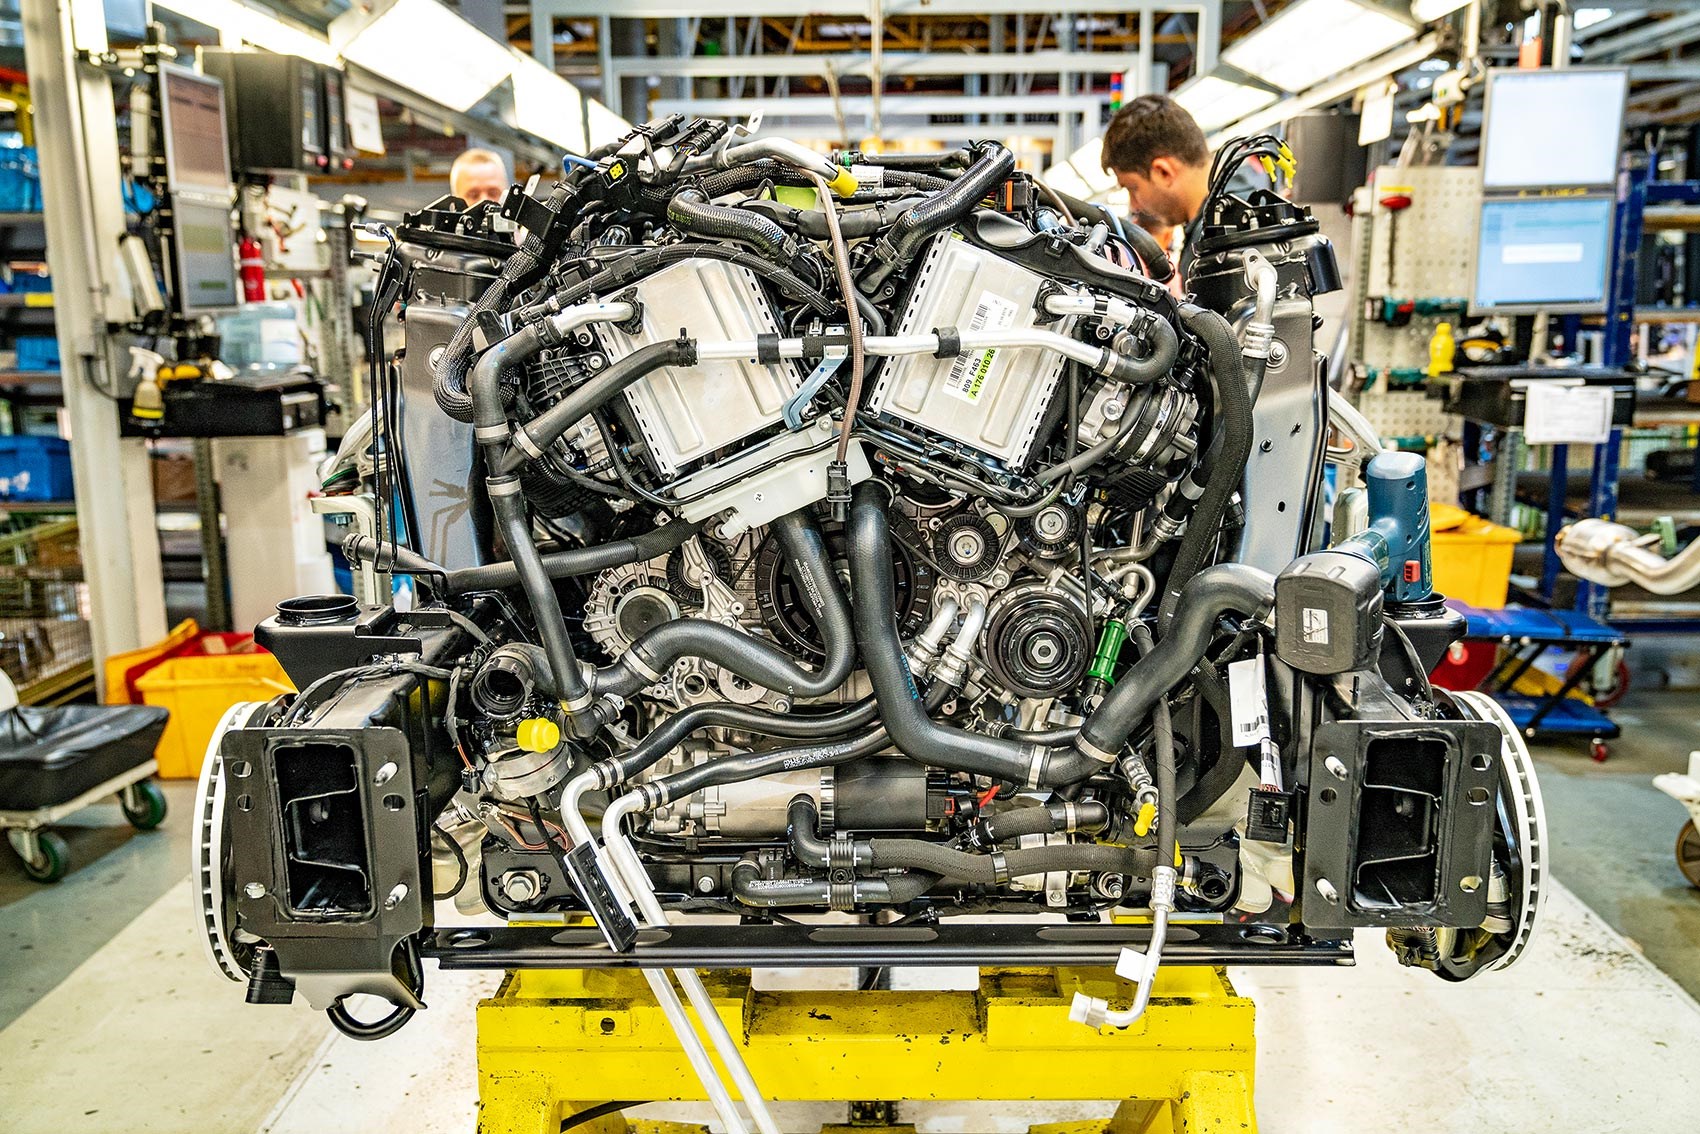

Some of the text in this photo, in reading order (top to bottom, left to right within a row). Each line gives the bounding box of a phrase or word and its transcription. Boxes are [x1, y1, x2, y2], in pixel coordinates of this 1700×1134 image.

[962, 379, 973, 393] 809
[969, 357, 982, 376] F463
[974, 374, 984, 388] 176
[980, 359, 991, 374] 010
[986, 348, 995, 358] 26
